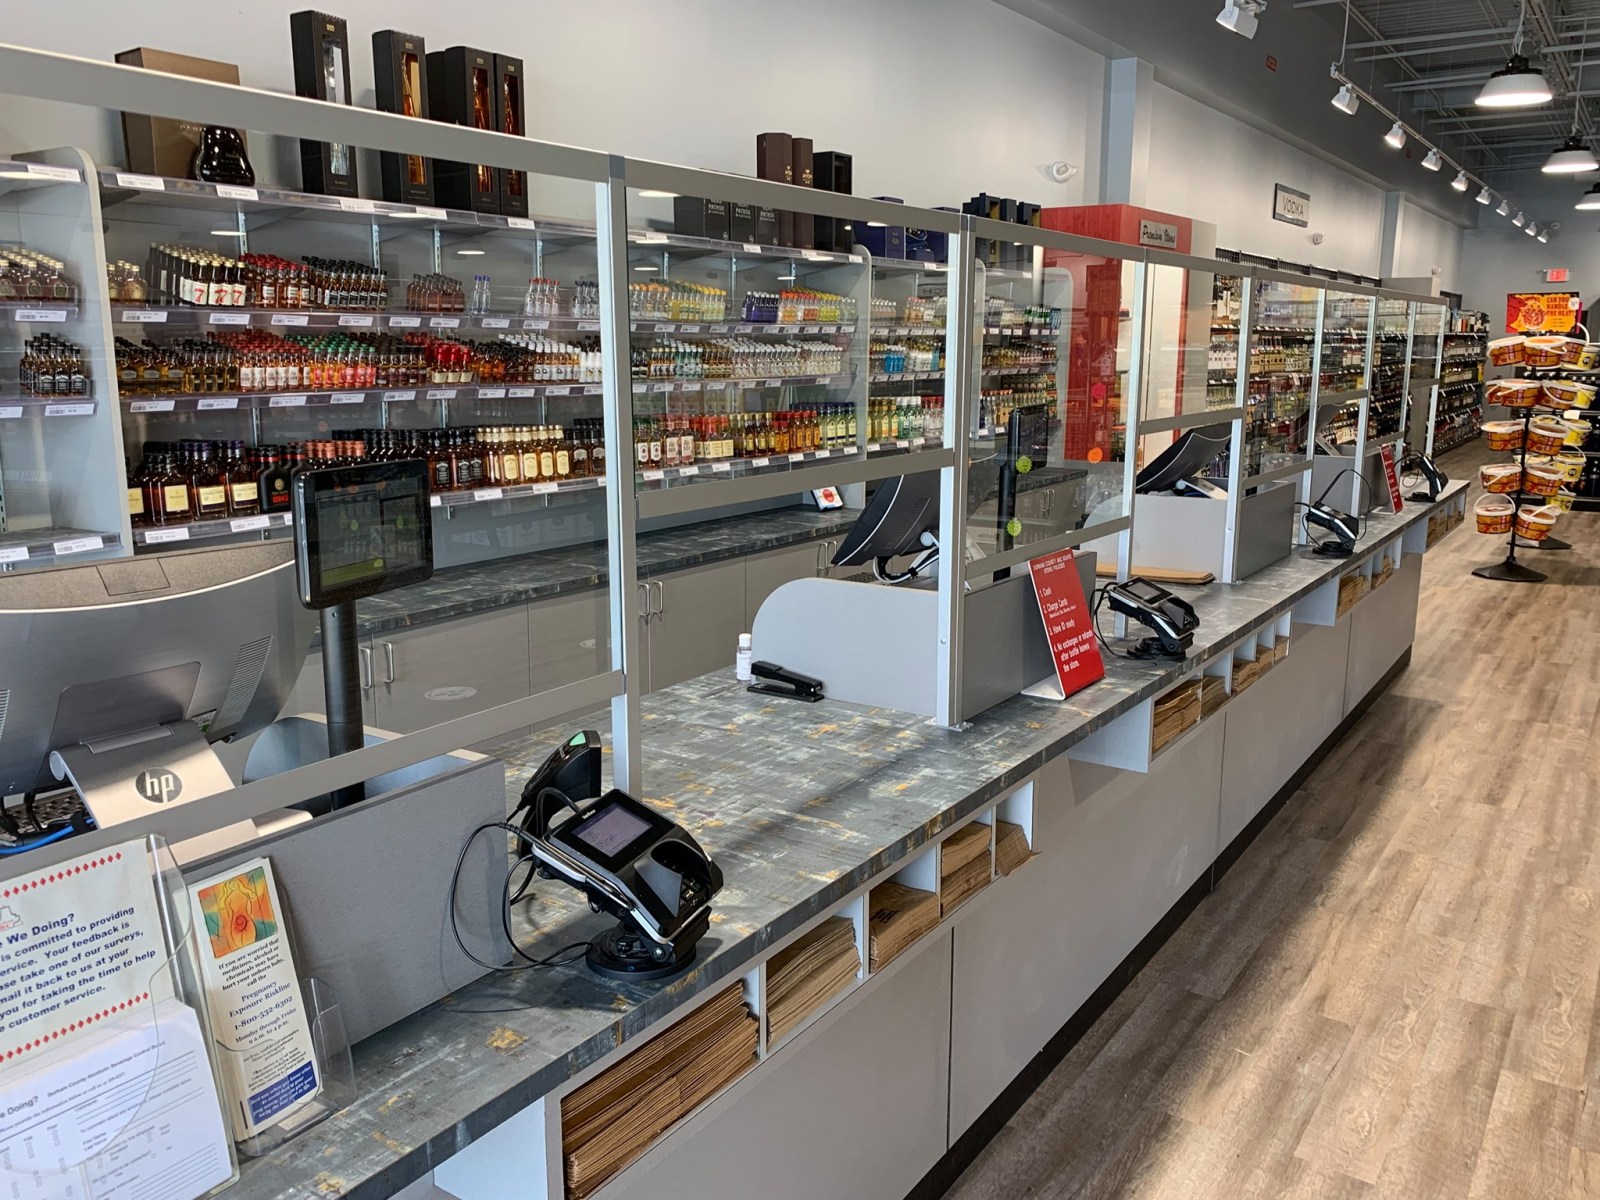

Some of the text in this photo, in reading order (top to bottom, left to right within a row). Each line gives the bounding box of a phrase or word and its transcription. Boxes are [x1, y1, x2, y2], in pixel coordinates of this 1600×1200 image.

[1283, 195, 1304, 217] VODKA
[1143, 224, 1162, 241] Premium
[1550, 269, 1567, 281] EXIT
[194, 288, 205, 303] 7
[233, 289, 243, 304] 7
[1042, 586, 1052, 597] Cash
[1047, 602, 1059, 612] Charge
[1058, 598, 1068, 607] Cards
[1052, 625, 1061, 634] Have
[1061, 621, 1066, 630] ID
[1065, 618, 1075, 629] ready
[1057, 642, 1063, 651] No
[1062, 637, 1079, 649] exchanges
[1078, 634, 1082, 642] or
[1082, 629, 1093, 640] refunds
[1061, 642, 1090, 662] after bottle leaves
[1070, 660, 1080, 670] store.
[145, 770, 174, 804] hp
[1, 953, 11, 962] is
[14, 930, 73, 957] committed
[76, 926, 87, 934] to
[90, 907, 134, 931] providing
[6, 934, 28, 945] We
[32, 913, 75, 936] Doing?
[0, 920, 130, 977] ervice. Your feedback is
[20, 968, 45, 983] take
[49, 961, 69, 971] one
[71, 954, 82, 963] of
[85, 948, 101, 958] our
[104, 931, 144, 951] surveys,
[222, 960, 253, 976] medicines,
[253, 948, 272, 961] alcohol
[225, 959, 236, 969] you
[247, 943, 268, 957] worried
[268, 938, 279, 948] that
[24, 986, 33, 994] it
[36, 975, 63, 990] back
[66, 970, 77, 978] to
[80, 964, 93, 973] us
[95, 958, 106, 967] at
[109, 948, 130, 963] your
[222, 958, 285, 991] hurt your unborn baby.
[226, 953, 279, 982] chemicals may have
[247, 974, 267, 987] call the
[0, 950, 156, 1020] you for taking the time to help
[241, 981, 277, 1002] Pregnancy
[8, 986, 106, 1029] customer service.
[229, 982, 291, 1018] Exposure Riskline
[234, 996, 293, 1030] 1-800-532-6302
[235, 1008, 297, 1043] Monday through Friday
[47, 1086, 68, 1098] Durham
[68, 1077, 87, 1091] County
[110, 1055, 133, 1069] Beverage
[133, 1046, 151, 1058] Control
[7, 1095, 39, 1115] Doing?
